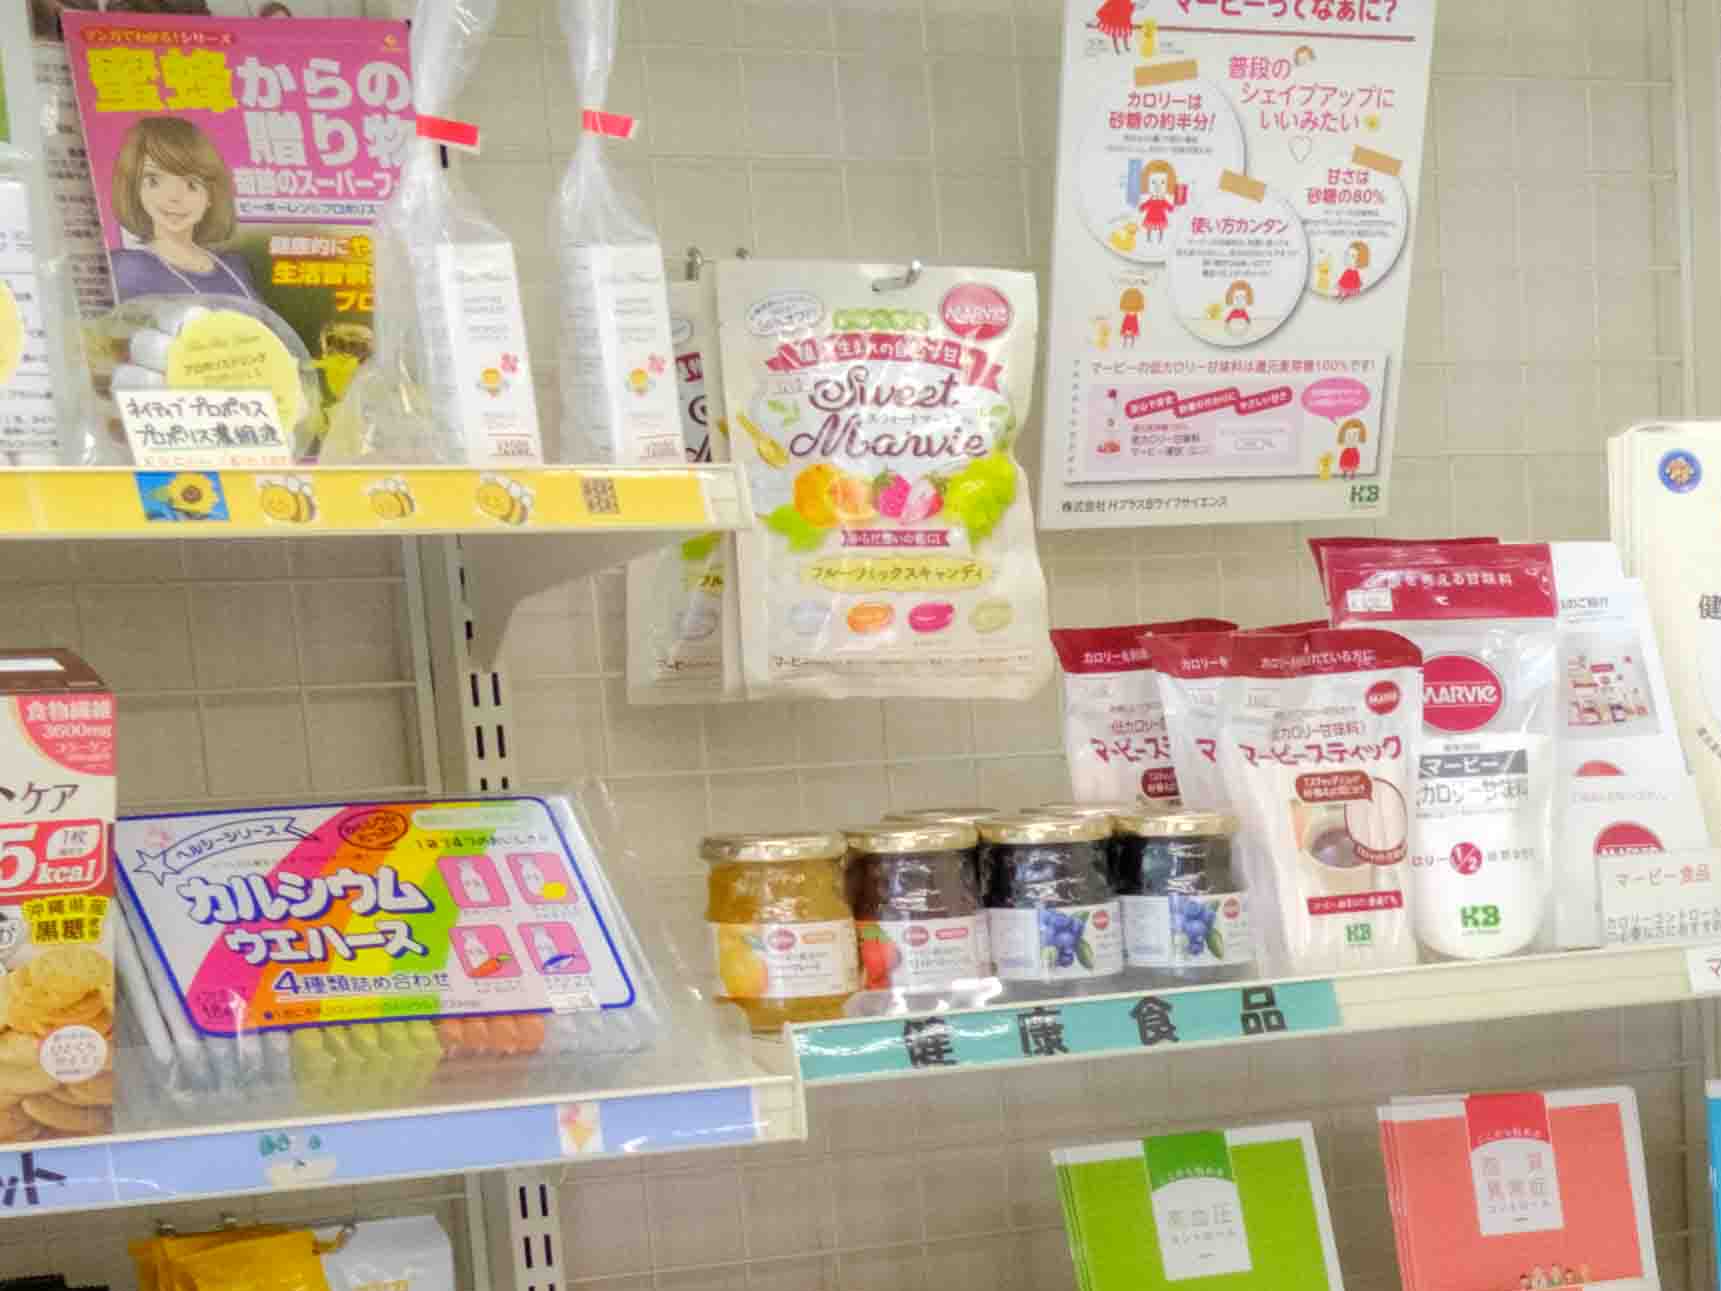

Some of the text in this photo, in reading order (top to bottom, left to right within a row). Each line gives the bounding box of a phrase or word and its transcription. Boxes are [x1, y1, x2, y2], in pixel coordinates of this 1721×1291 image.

[1228, 56, 1293, 80] 普段の
[1126, 92, 1203, 111] カロリーは
[1259, 112, 1362, 134] いいみたい
[1327, 168, 1370, 185] 甘さは
[1237, 735, 1402, 767] マービースティック
[36, 857, 99, 887] kcal
[175, 867, 437, 924] カルシウム
[223, 920, 430, 967] ウエハース
[903, 985, 1287, 1068] 健康食品
